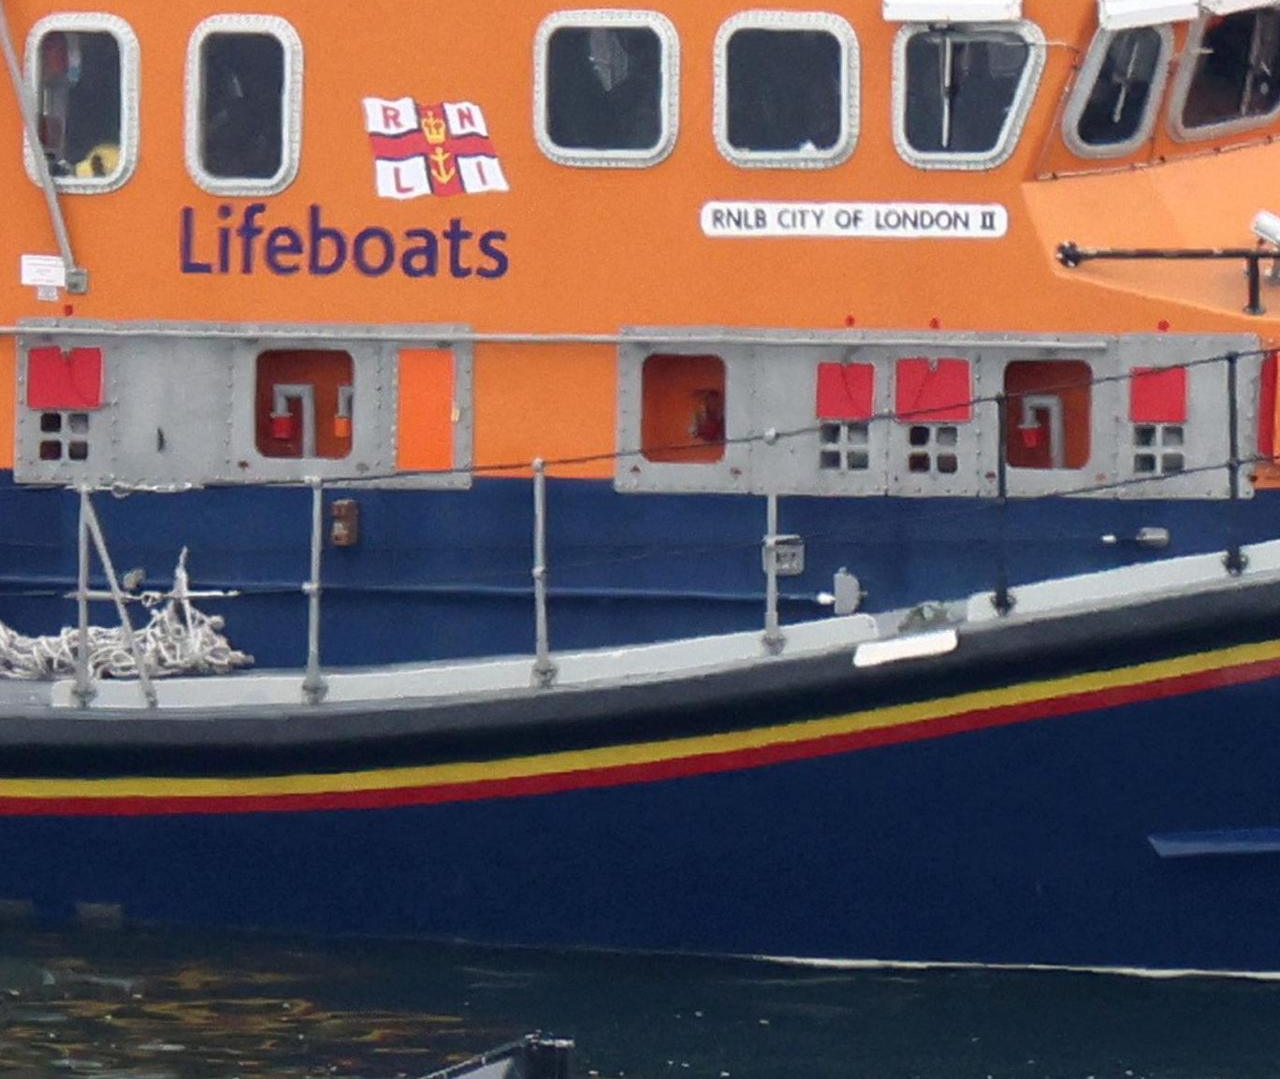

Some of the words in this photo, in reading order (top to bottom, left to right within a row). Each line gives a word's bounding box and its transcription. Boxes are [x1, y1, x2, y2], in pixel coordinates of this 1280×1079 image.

[382, 105, 403, 129] R
[456, 108, 476, 130] N
[394, 167, 413, 193] L
[712, 208, 768, 229] RNLB
[777, 209, 824, 229] CITY
[834, 210, 864, 230] OF
[874, 209, 970, 230] LONDON
[179, 203, 510, 278] Lifeboats
